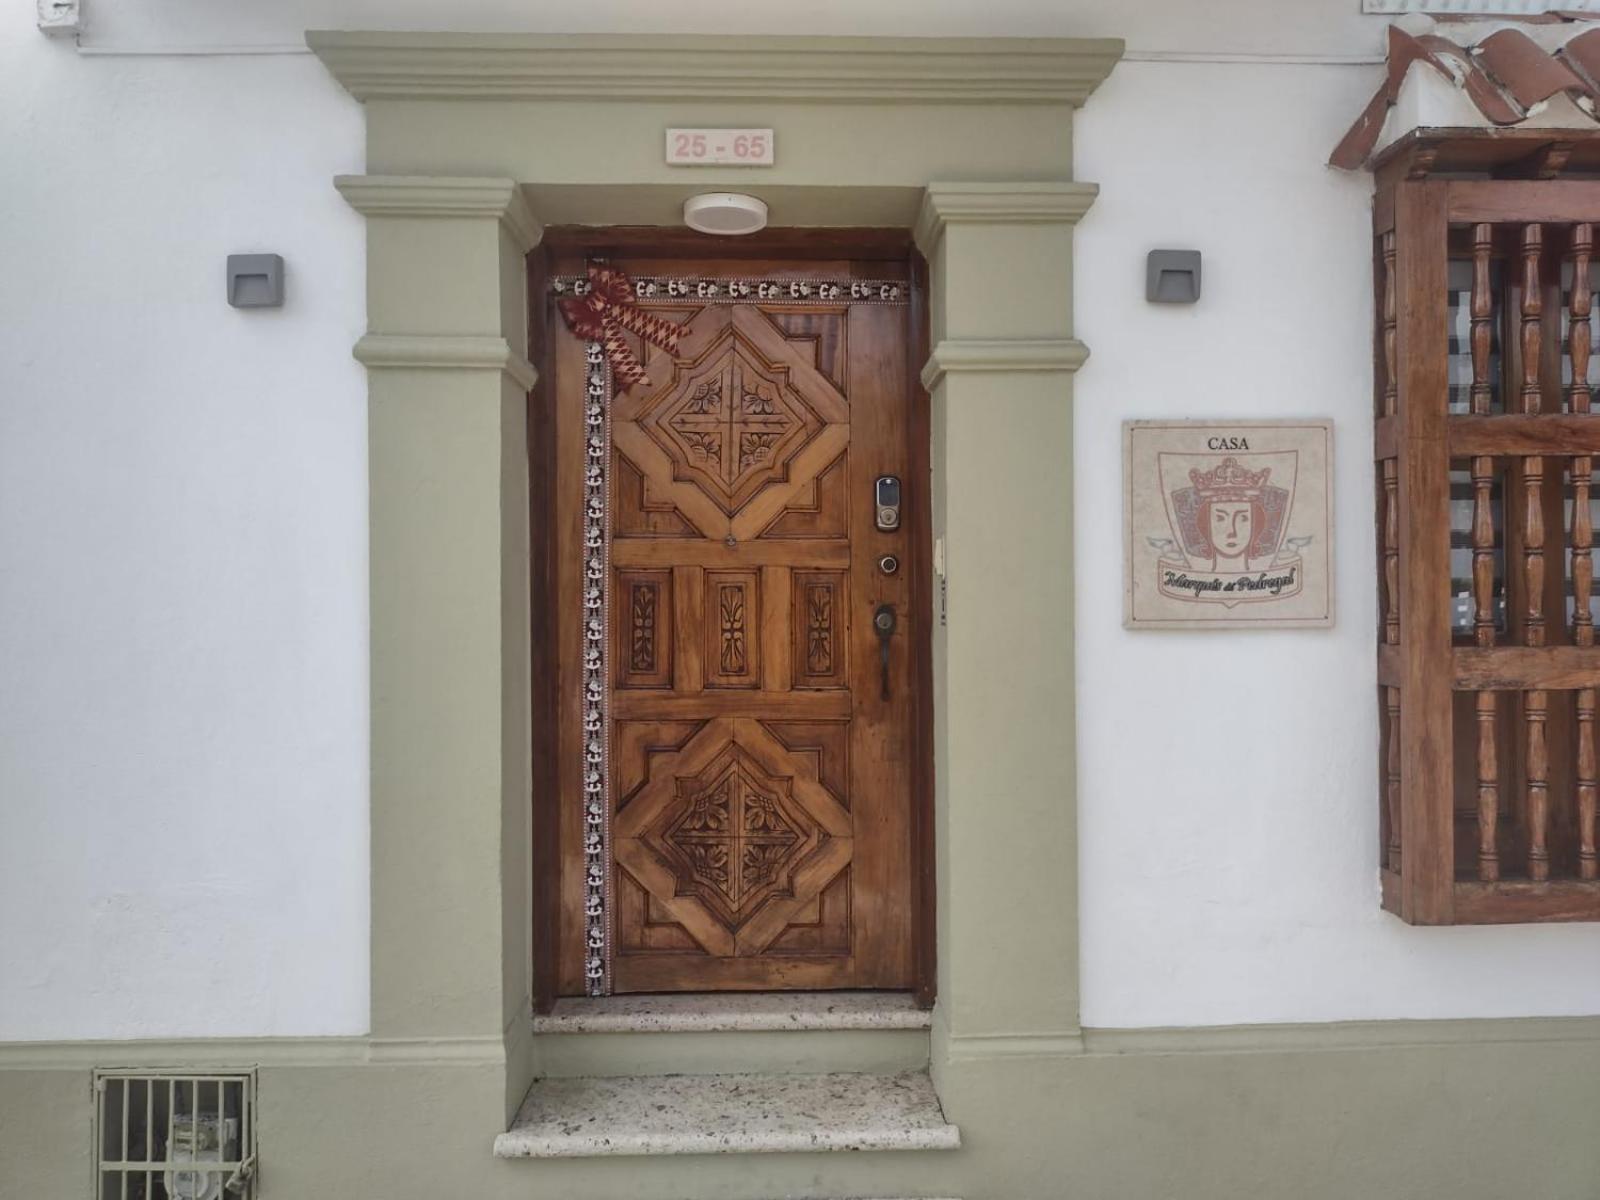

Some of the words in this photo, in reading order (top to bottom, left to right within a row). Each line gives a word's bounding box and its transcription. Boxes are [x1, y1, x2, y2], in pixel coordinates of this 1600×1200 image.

[675, 134, 706, 157] 25
[734, 134, 766, 158] 65
[1207, 436, 1249, 450] CASA
